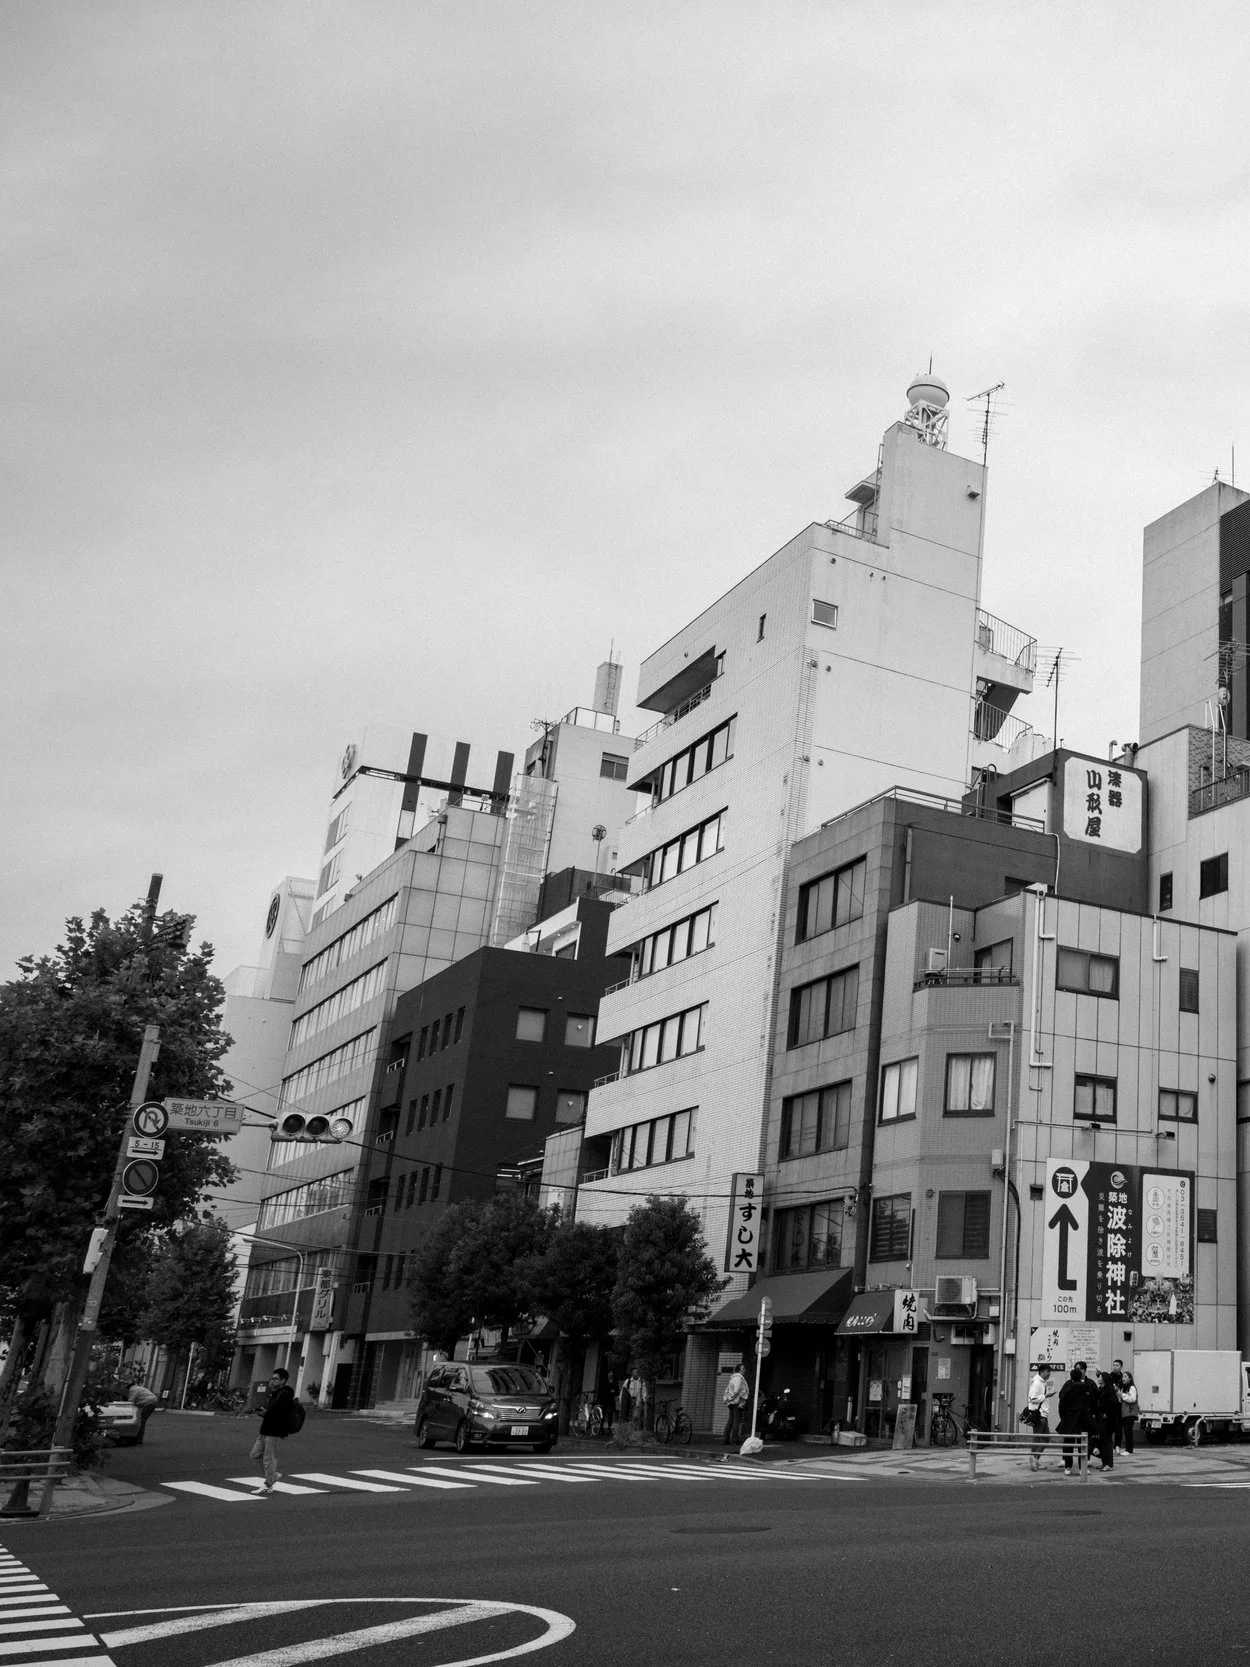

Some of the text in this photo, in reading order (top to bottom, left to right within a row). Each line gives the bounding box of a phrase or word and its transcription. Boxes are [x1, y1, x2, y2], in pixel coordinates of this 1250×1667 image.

[1108, 769, 1122, 808] 漆器
[170, 1102, 237, 1119] 築地六丁目
[184, 1117, 219, 1127] Tsukiji 6
[744, 1177, 755, 1199] 築地
[1108, 1191, 1128, 1204] 築地
[734, 1202, 757, 1269] すし大
[1105, 1205, 1127, 1315] 波除神社
[902, 1293, 917, 1331] 焼肉
[1053, 1304, 1077, 1313] 100m
